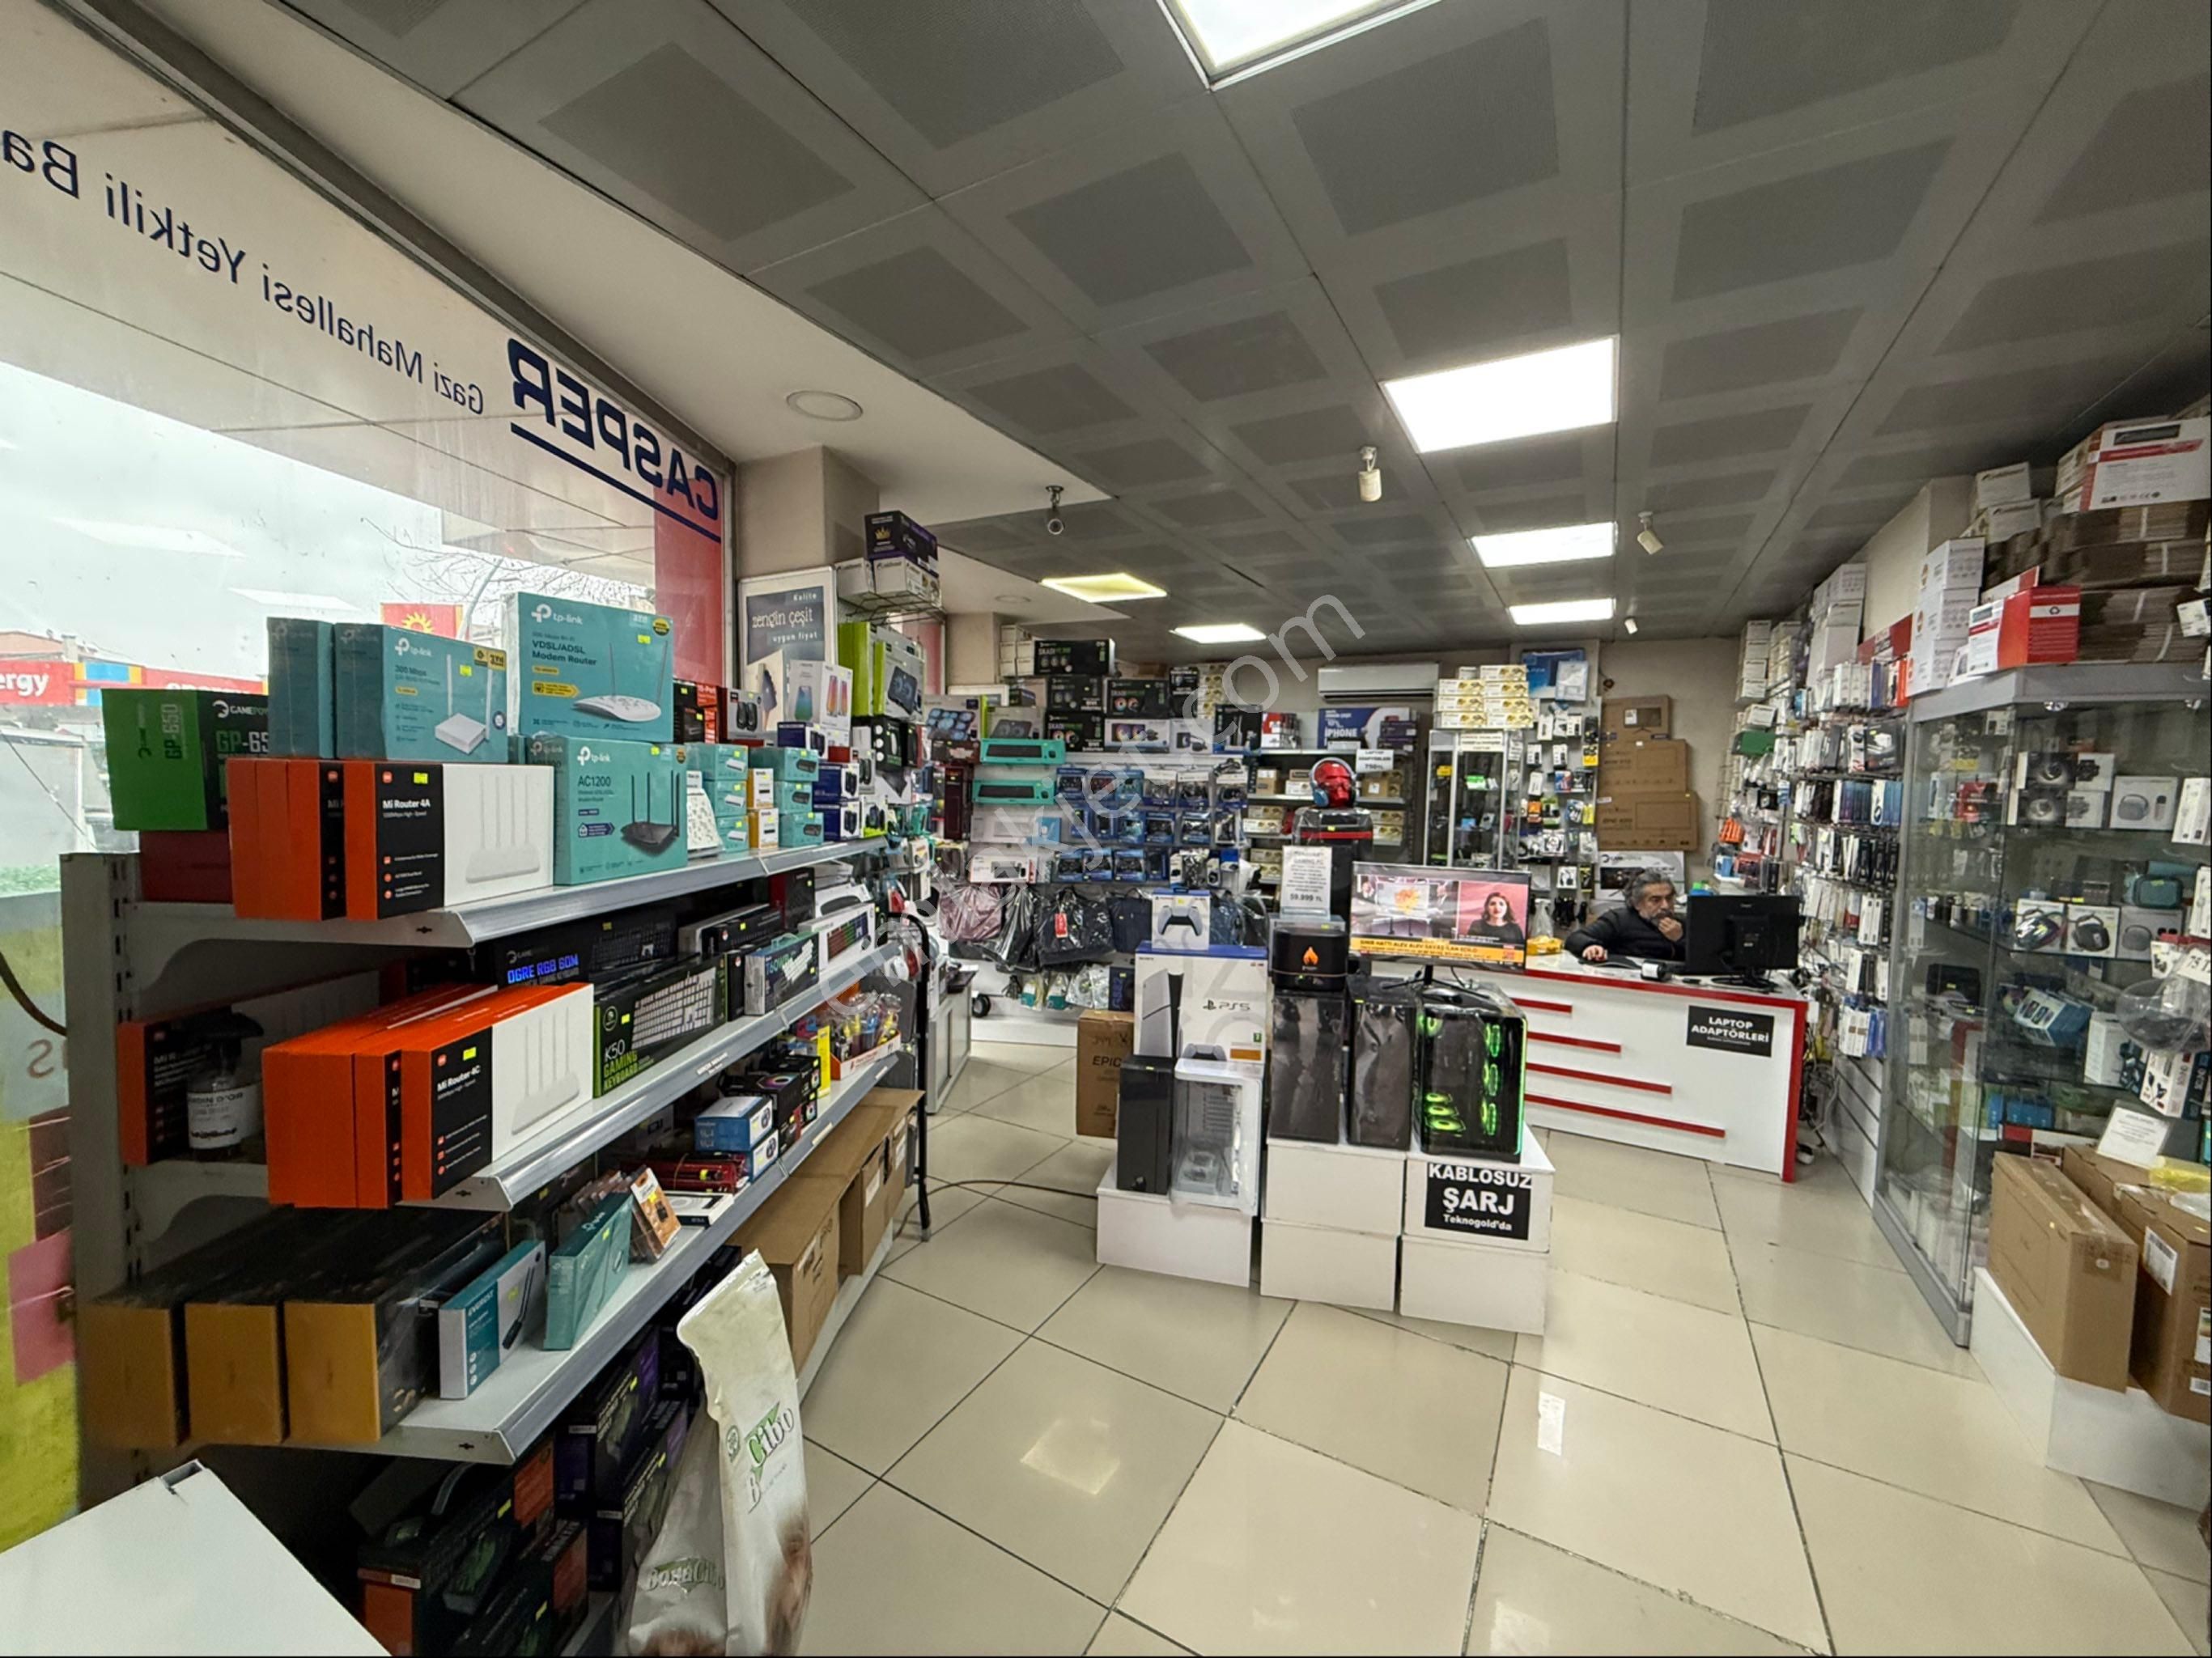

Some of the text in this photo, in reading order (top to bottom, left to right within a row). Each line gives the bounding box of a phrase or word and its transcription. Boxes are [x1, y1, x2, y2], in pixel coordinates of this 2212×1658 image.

[553, 613, 583, 625] tp-link
[751, 607, 813, 629] zengin çeşit
[532, 640, 586, 655] VDSL/ADSL
[532, 651, 597, 666] Modem Router
[216, 730, 268, 753] GP-65
[577, 776, 612, 787] AC1200
[383, 799, 431, 809] Mi Router 4A
[507, 965, 535, 984] OGRE
[1220, 1002, 1250, 1011] PS5
[1709, 1016, 1754, 1029] LAPTOP
[1691, 1024, 1769, 1042] ADAPTÖRLERİ
[605, 1039, 626, 1061] K50
[603, 1050, 639, 1078] GAMING
[1093, 1055, 1122, 1067] EPIC
[437, 1079, 448, 1092] Mi
[448, 1071, 471, 1087] Router
[604, 1062, 639, 1091] KEYBOARD
[1429, 1164, 1533, 1189] KABLOSUZ
[1442, 1187, 1514, 1215] ŞARJ
[1443, 1214, 1513, 1231] Teknogold'da
